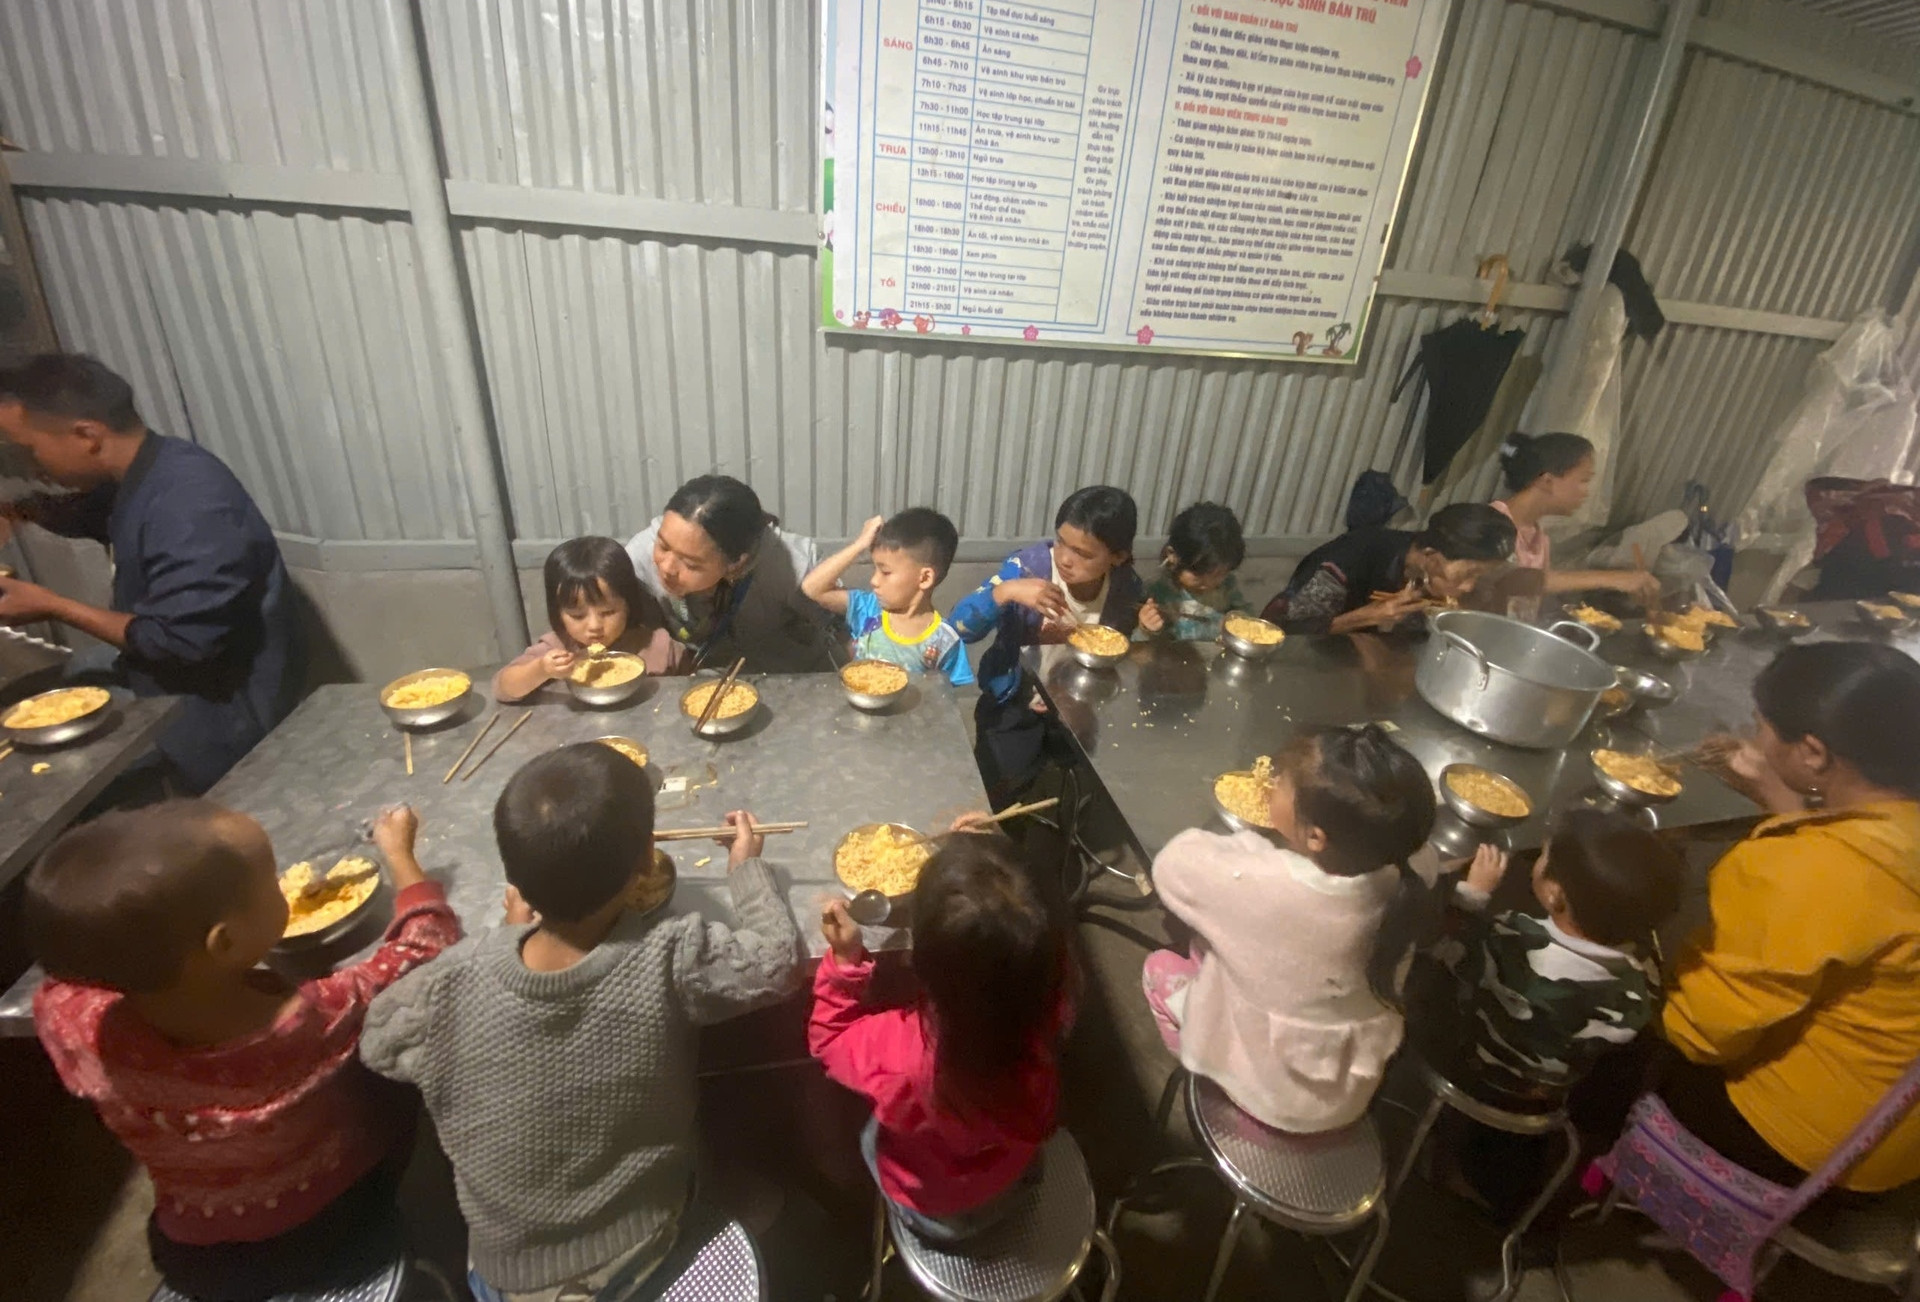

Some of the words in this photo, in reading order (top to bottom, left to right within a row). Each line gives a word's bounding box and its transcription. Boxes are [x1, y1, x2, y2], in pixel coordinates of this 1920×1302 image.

[1328, 1, 1352, 18] BÁN
[925, 15, 944, 26] 6h15
[952, 19, 971, 30] 6h30
[884, 37, 913, 51] SÁNG
[924, 35, 943, 46] 6h30
[951, 40, 970, 50] 6h45
[923, 56, 942, 66] 6h45
[950, 60, 968, 70] 7h10
[922, 78, 940, 89] 7h10
[948, 82, 966, 93] 7h25
[920, 101, 938, 111] 7h30
[946, 105, 968, 115] 11h00
[879, 144, 906, 155] TRƯA
